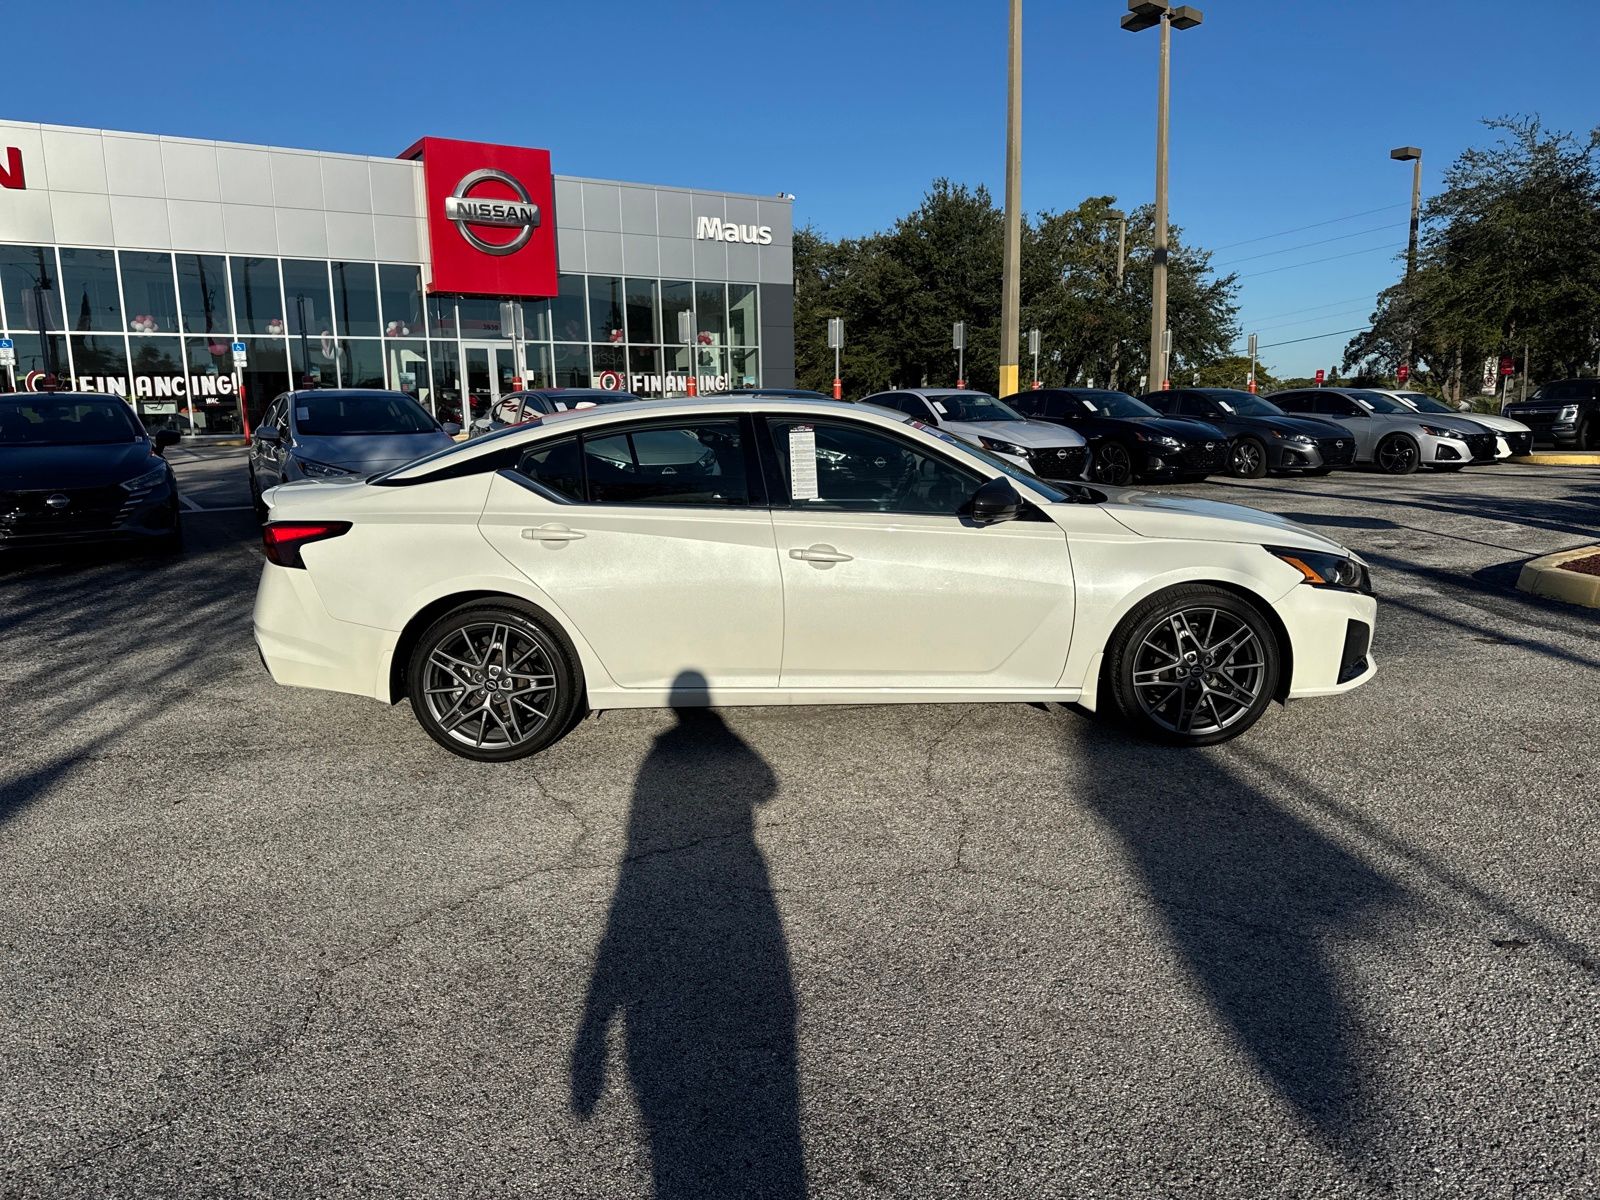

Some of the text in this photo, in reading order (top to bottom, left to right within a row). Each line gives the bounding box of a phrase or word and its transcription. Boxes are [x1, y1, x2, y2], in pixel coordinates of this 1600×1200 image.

[456, 202, 533, 221] NISSAN
[697, 216, 773, 245] Maus
[79, 372, 238, 397] FINANCING!
[632, 372, 730, 392] FINANING!
